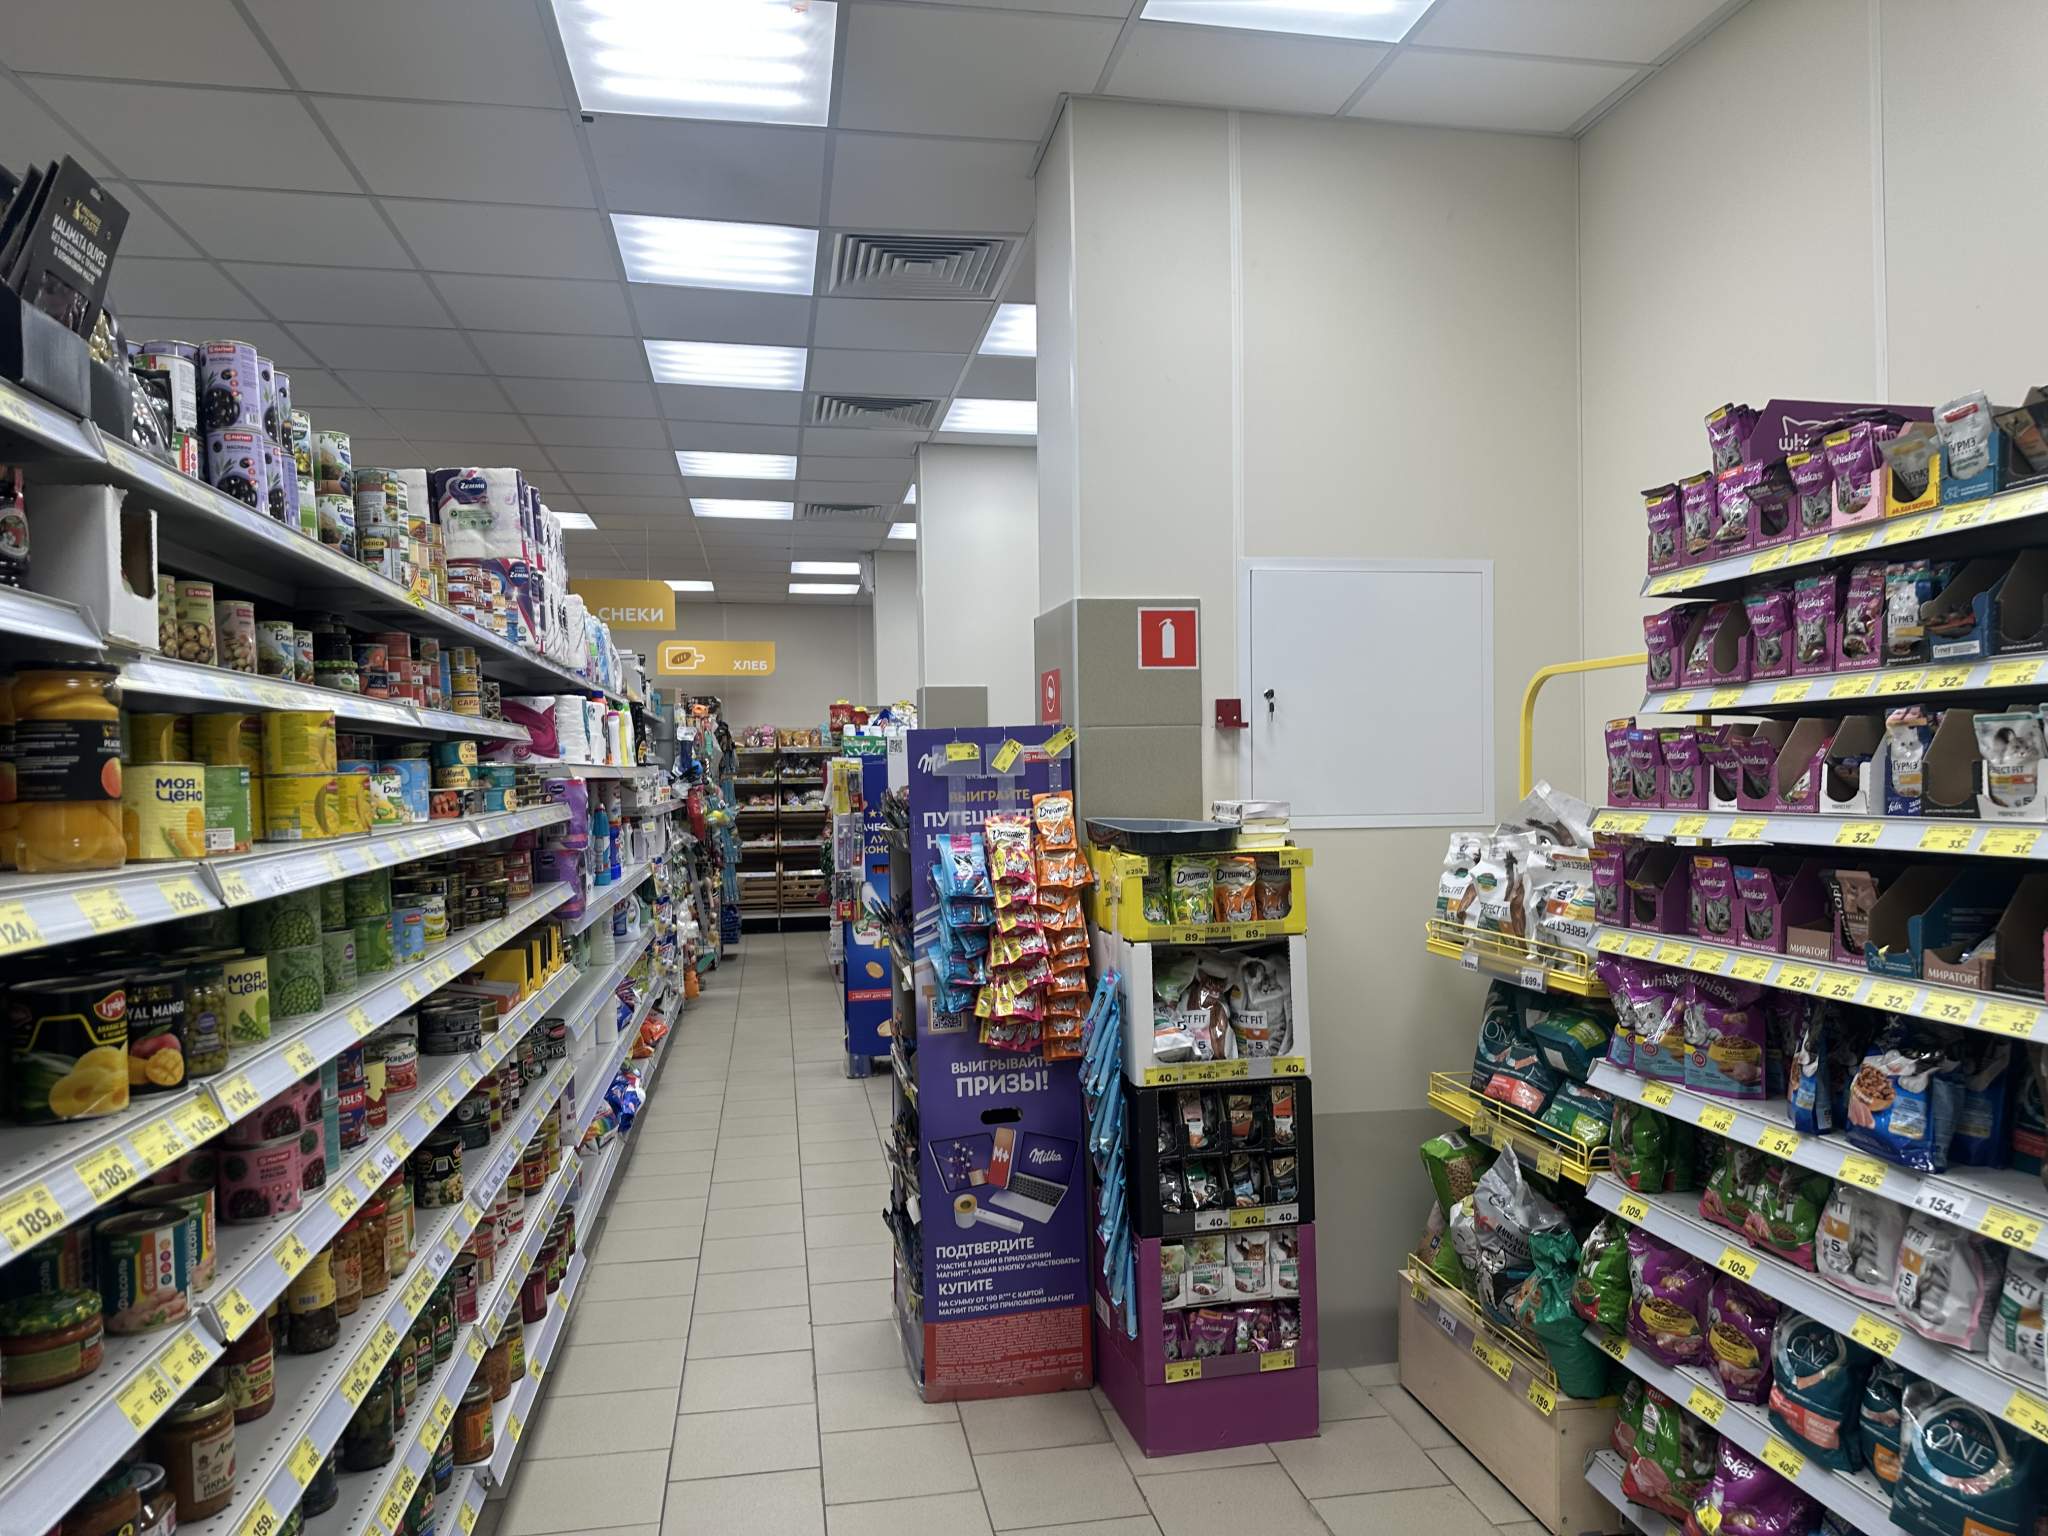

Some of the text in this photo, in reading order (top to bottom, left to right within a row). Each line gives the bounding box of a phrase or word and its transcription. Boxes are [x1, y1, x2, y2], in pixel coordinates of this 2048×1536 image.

[52, 214, 108, 268] KALAMATA OLIVES
[1779, 432, 1810, 451] whi
[599, 607, 664, 622] СНЕКИ
[733, 660, 768, 671] ХЛЕБ
[951, 788, 1030, 802] ВЫИГРАЙТЕ
[1177, 870, 1210, 884] Dreamies
[1216, 868, 1252, 881] Dreamies
[1185, 933, 1198, 942] 89
[1246, 930, 1259, 938] 89
[1789, 943, 1830, 958] МИРАТОРГ
[1790, 976, 1803, 988] 25
[1928, 967, 1978, 985] МИРАТОРГ
[153, 1001, 184, 1016] MANGO
[1194, 1014, 1206, 1023] FIT
[1251, 1015, 1263, 1024] FIT
[1286, 1065, 1298, 1073] 40
[956, 1071, 1049, 1097] ПРИЗЫ!
[1159, 1074, 1172, 1082] 40
[1774, 1141, 1788, 1153] 51
[1029, 1148, 1063, 1164] Milka
[101, 1163, 127, 1191] 189
[1625, 1205, 1640, 1218] 109
[1928, 1196, 1952, 1215] 154
[17, 1207, 51, 1237] 189
[1210, 1219, 1222, 1227] 40
[1245, 1216, 1258, 1225] 40
[1279, 1213, 1292, 1221] 40
[2001, 1226, 2023, 1243] 69
[936, 1237, 1035, 1259] ПОДТВЕРДИТЕ
[936, 1261, 966, 1271] УЧАСТИЕ
[973, 1258, 997, 1267] АКЦИИ
[1004, 1252, 1052, 1263] ПРИЛОЖЕНИИ
[972, 1266, 997, 1275] НАЖАВ
[998, 1263, 1025, 1272] КНОПКУ
[1727, 1261, 1745, 1275] 109
[939, 1279, 993, 1295] КУПИТЕ
[939, 1299, 949, 1307] НА
[950, 1297, 975, 1307] СУММУ
[976, 1296, 984, 1304] ОТ
[1017, 1288, 1044, 1298] КАРТОЙ
[939, 1306, 966, 1315] МАГНИТ
[968, 1304, 989, 1312] ПЛЮС
[1000, 1298, 1047, 1308] ПРИЛОЖЕНИЯ
[1047, 1293, 1075, 1303] МАГНИТ
[150, 1387, 168, 1406] 159
[1535, 1394, 1549, 1409] 159
[1927, 1424, 1994, 1469] ONE
[254, 1514, 273, 1536] 159
